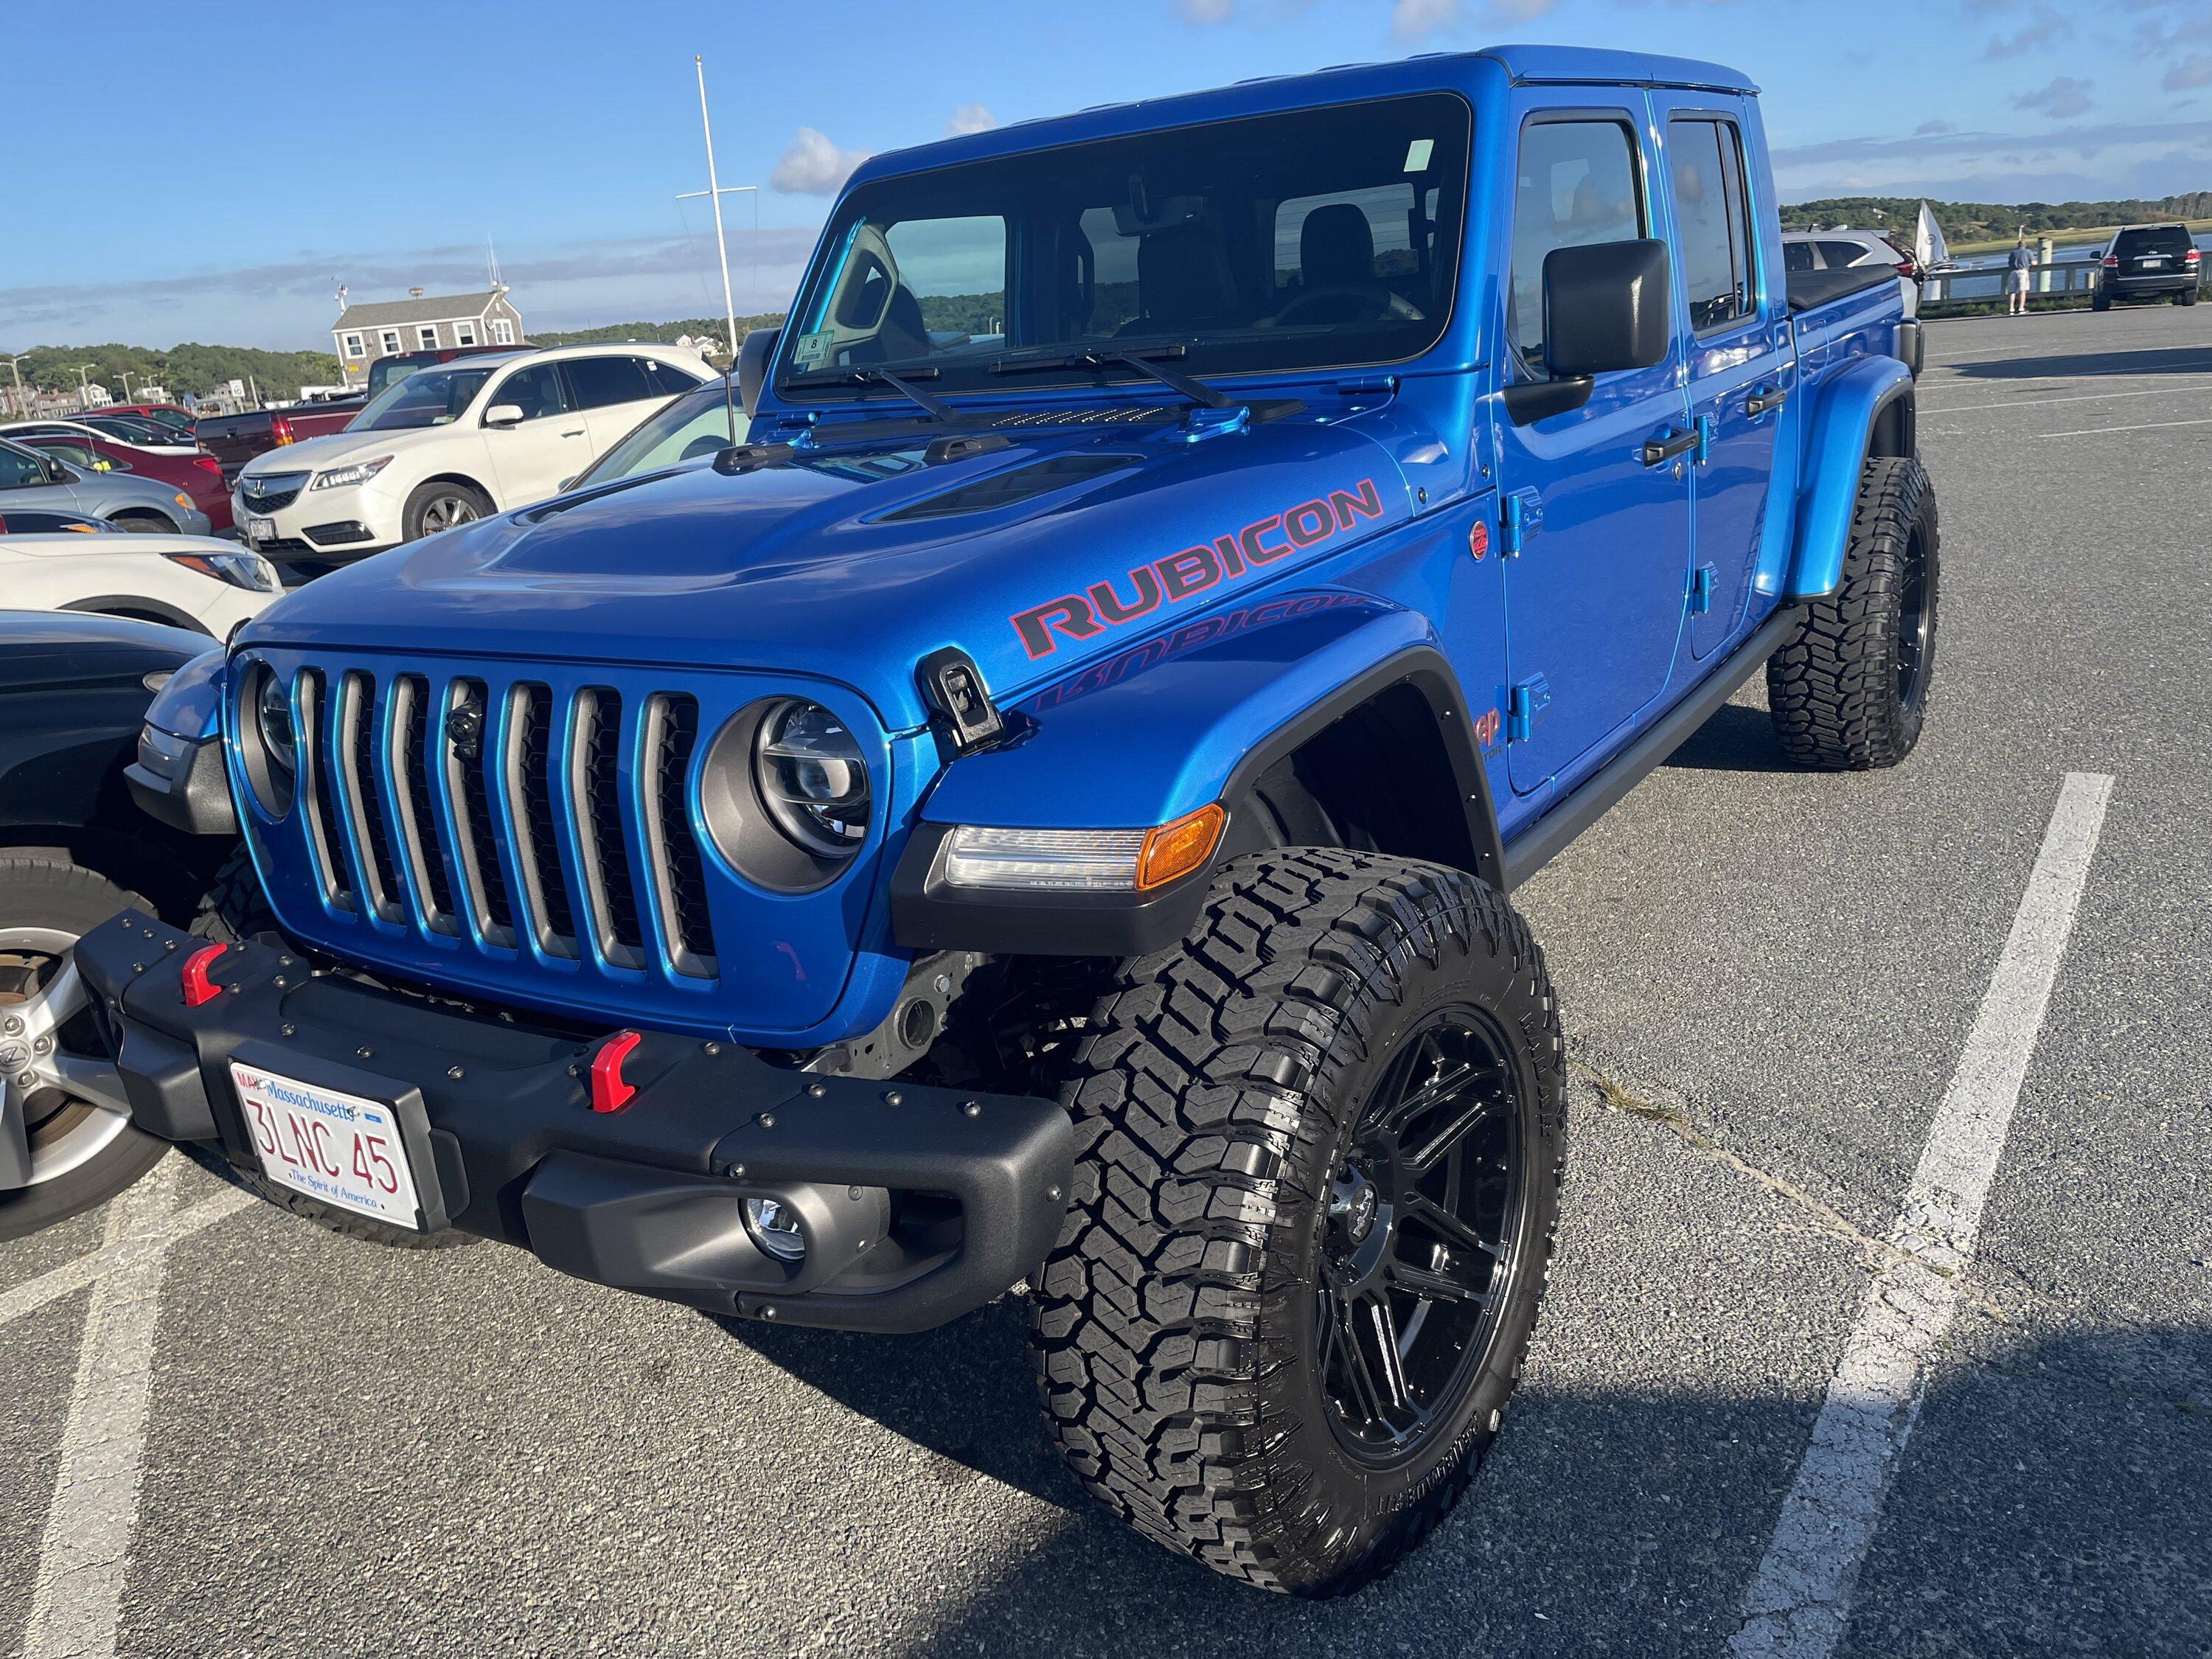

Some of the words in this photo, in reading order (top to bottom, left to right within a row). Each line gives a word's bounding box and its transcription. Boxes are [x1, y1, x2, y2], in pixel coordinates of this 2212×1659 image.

[811, 339, 818, 349] 8
[1009, 479, 1383, 660] RUBICON
[1475, 708, 1500, 747] ep
[267, 1081, 355, 1121] Massachusetts
[246, 1098, 341, 1177] 3LNC
[352, 1129, 398, 1194] 45
[291, 1169, 306, 1183] The
[307, 1175, 329, 1192] Spirit
[331, 1184, 340, 1196] of
[341, 1189, 378, 1208] America
